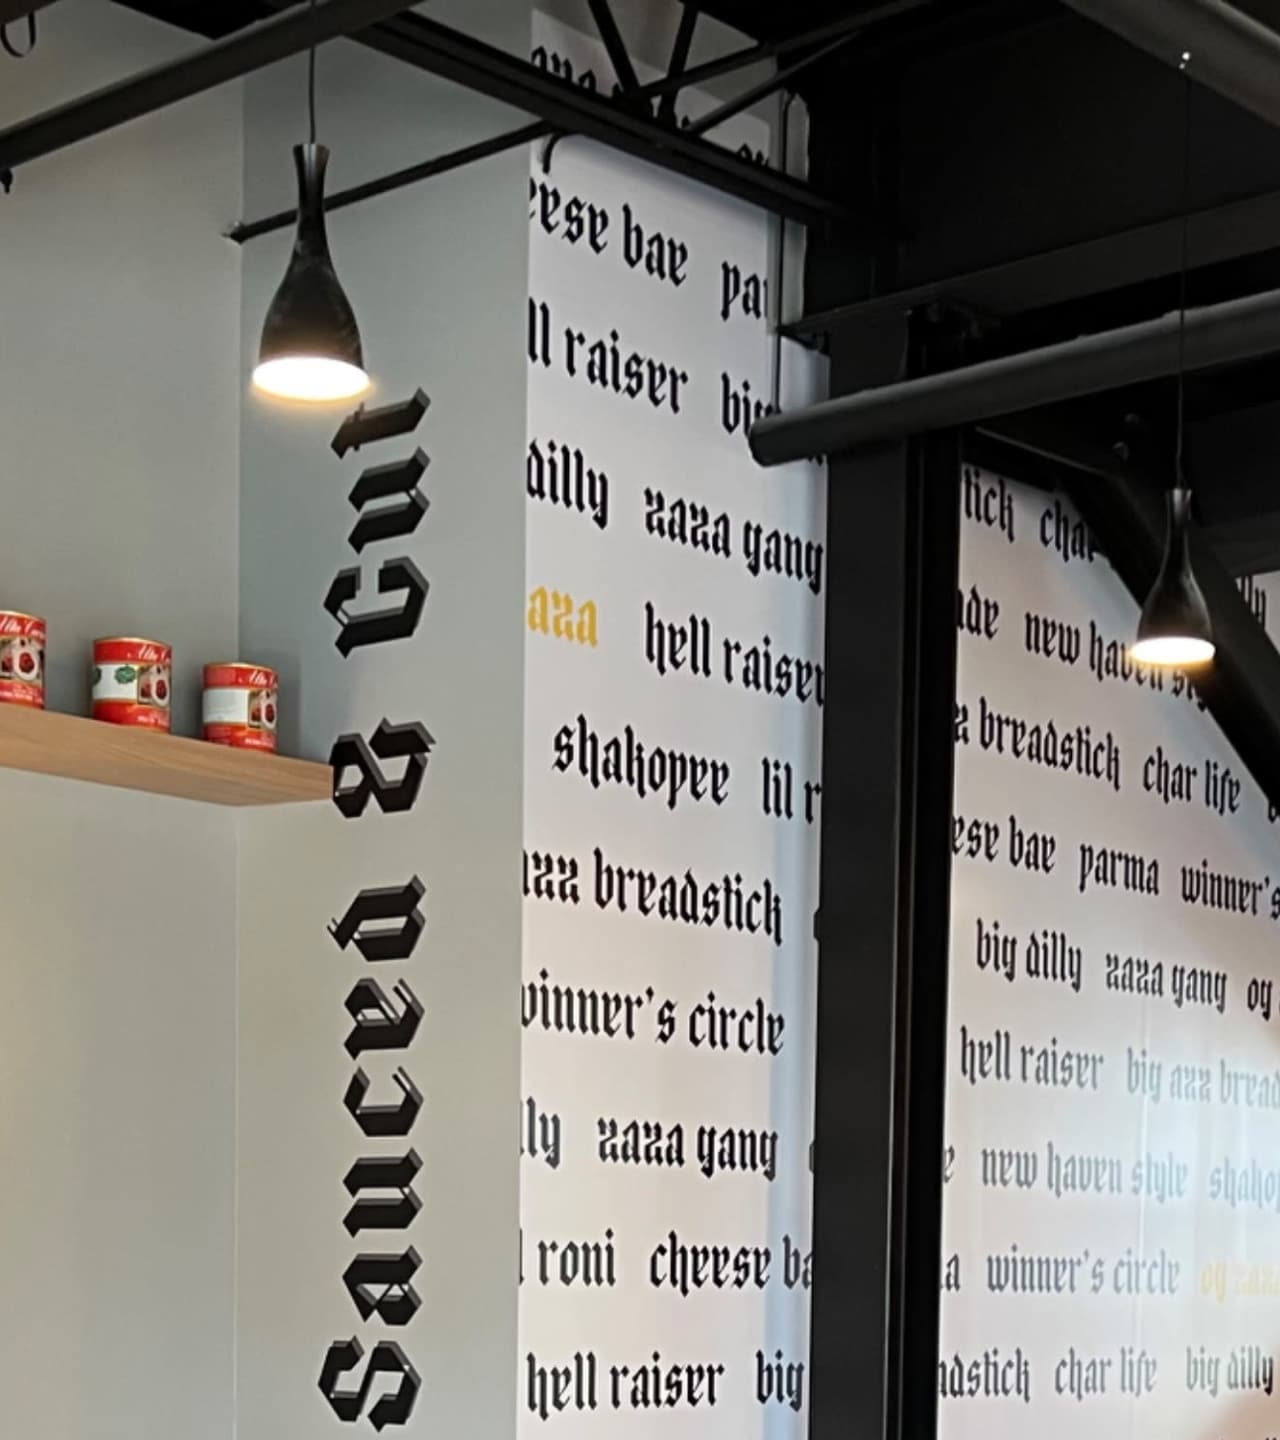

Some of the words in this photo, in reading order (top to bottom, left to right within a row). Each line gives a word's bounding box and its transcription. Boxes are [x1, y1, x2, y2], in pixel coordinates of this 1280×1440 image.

[622, 203, 688, 287] bae
[565, 326, 689, 414] raiser
[526, 439, 608, 530] dilly
[644, 486, 731, 559] zaza
[743, 520, 824, 596] gang
[645, 600, 711, 677] hell
[1025, 610, 1081, 665] new
[327, 716, 437, 819] &
[553, 714, 729, 810] shakopee
[762, 757, 793, 821] lil
[980, 696, 1120, 791] breadstick
[1143, 746, 1198, 804] char
[1205, 759, 1241, 816] life
[1009, 815, 1056, 874] bae
[1079, 843, 1160, 895] parma
[594, 847, 783, 946] breadstick
[976, 918, 1017, 983] big
[1025, 930, 1082, 993] dilly
[1106, 952, 1164, 997] zaza
[1171, 965, 1228, 1014] gang
[1247, 977, 1272, 1021] og
[688, 992, 785, 1056] circle
[960, 1025, 1011, 1085] hell
[1020, 1037, 1105, 1091] raiser
[1127, 1047, 1162, 1104] big
[1169, 1064, 1212, 1104] azz
[317, 874, 427, 1434] Sauced
[597, 1116, 685, 1168] zaza
[696, 1126, 779, 1181] gang
[981, 1146, 1037, 1188] new
[1047, 1141, 1122, 1199] haven
[1131, 1152, 1188, 1203] style
[538, 1228, 616, 1287] roni
[649, 1230, 771, 1298] cheese
[986, 1243, 1104, 1295] winner's
[1113, 1248, 1180, 1296] circle
[526, 1350, 597, 1421] hell
[610, 1350, 725, 1409] raiser
[755, 1348, 806, 1414] big
[1054, 1346, 1112, 1402] char
[1120, 1346, 1158, 1396] life
[1185, 1346, 1219, 1397] big
[1227, 1346, 1274, 1396] dilly
